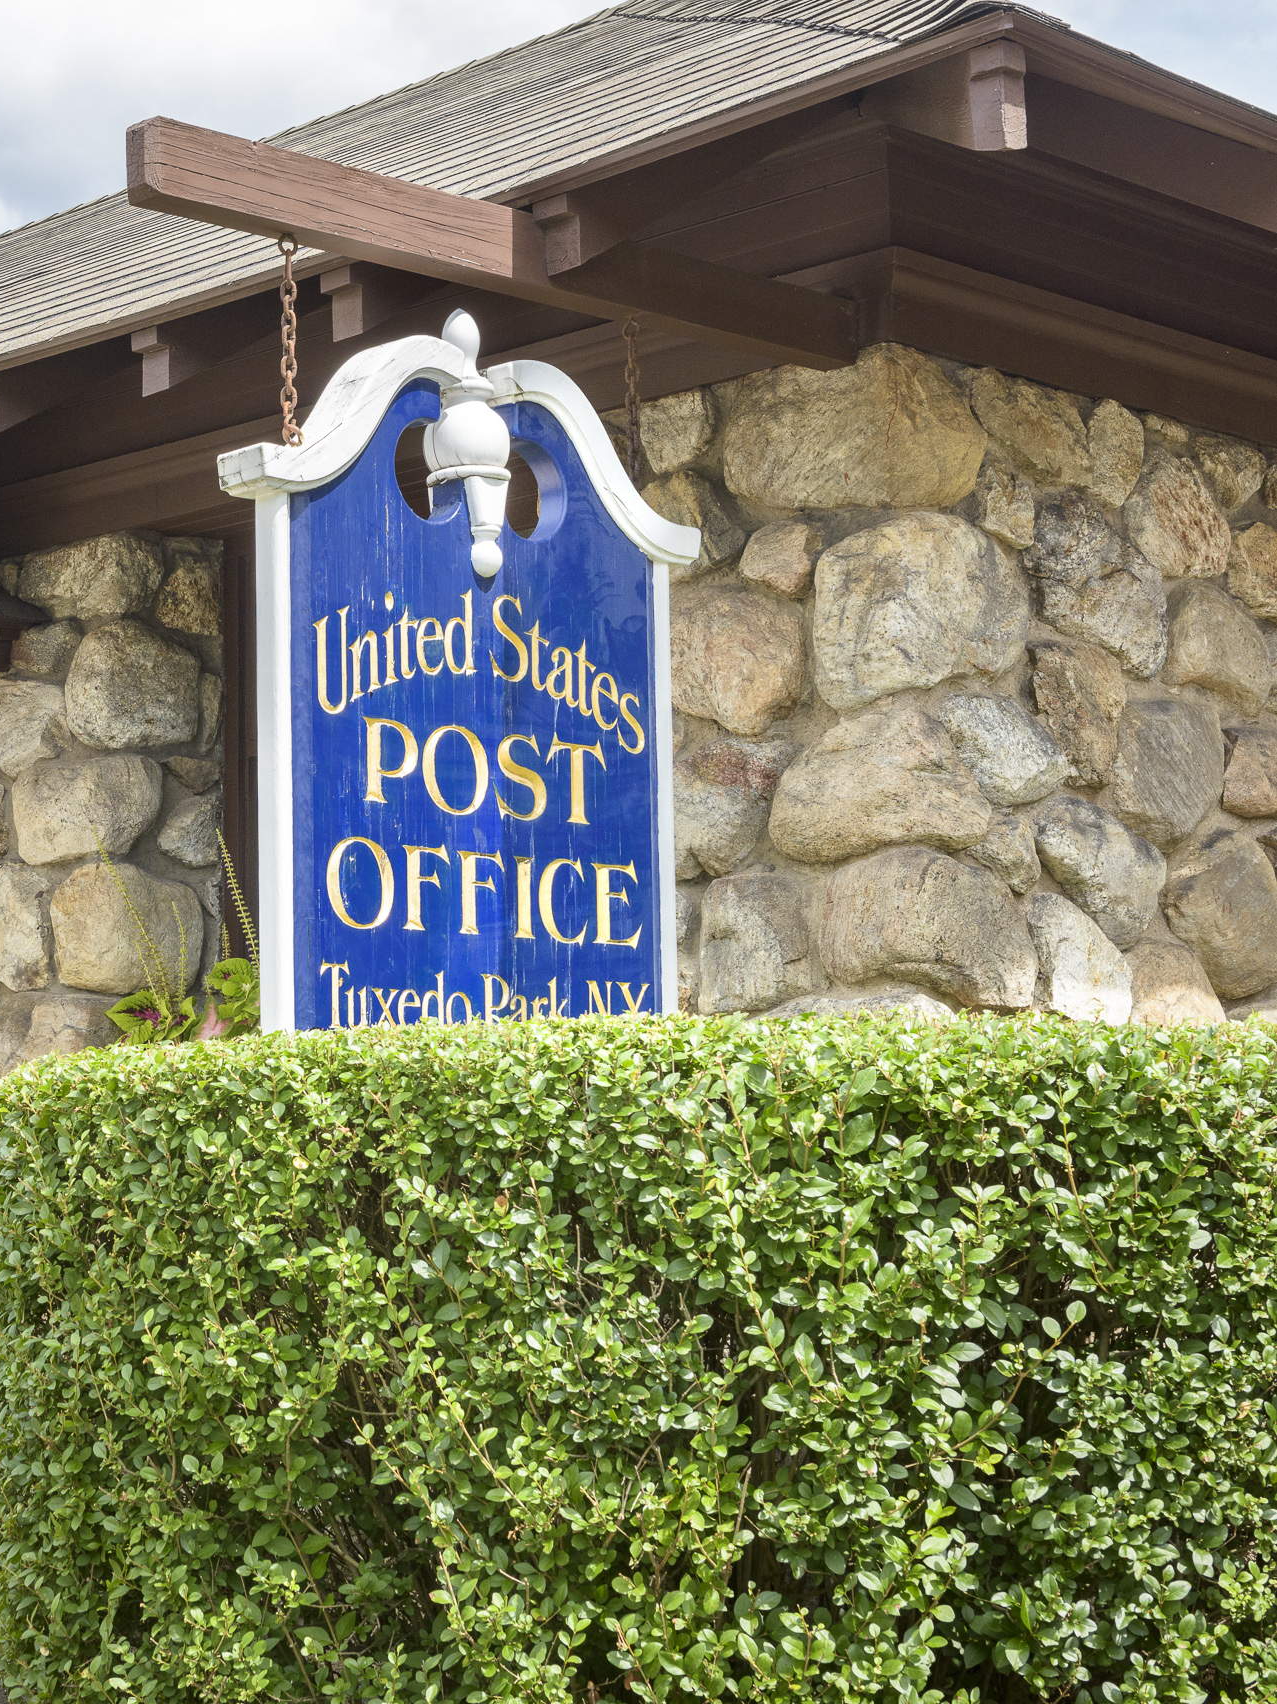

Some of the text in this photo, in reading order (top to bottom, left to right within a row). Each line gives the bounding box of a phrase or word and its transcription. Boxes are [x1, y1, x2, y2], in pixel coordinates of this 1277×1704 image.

[312, 588, 645, 754] United States
[362, 716, 606, 825] POST
[326, 836, 643, 950] OFFICE
[319, 958, 473, 1029] Tuxedo
[481, 972, 568, 1024] Park
